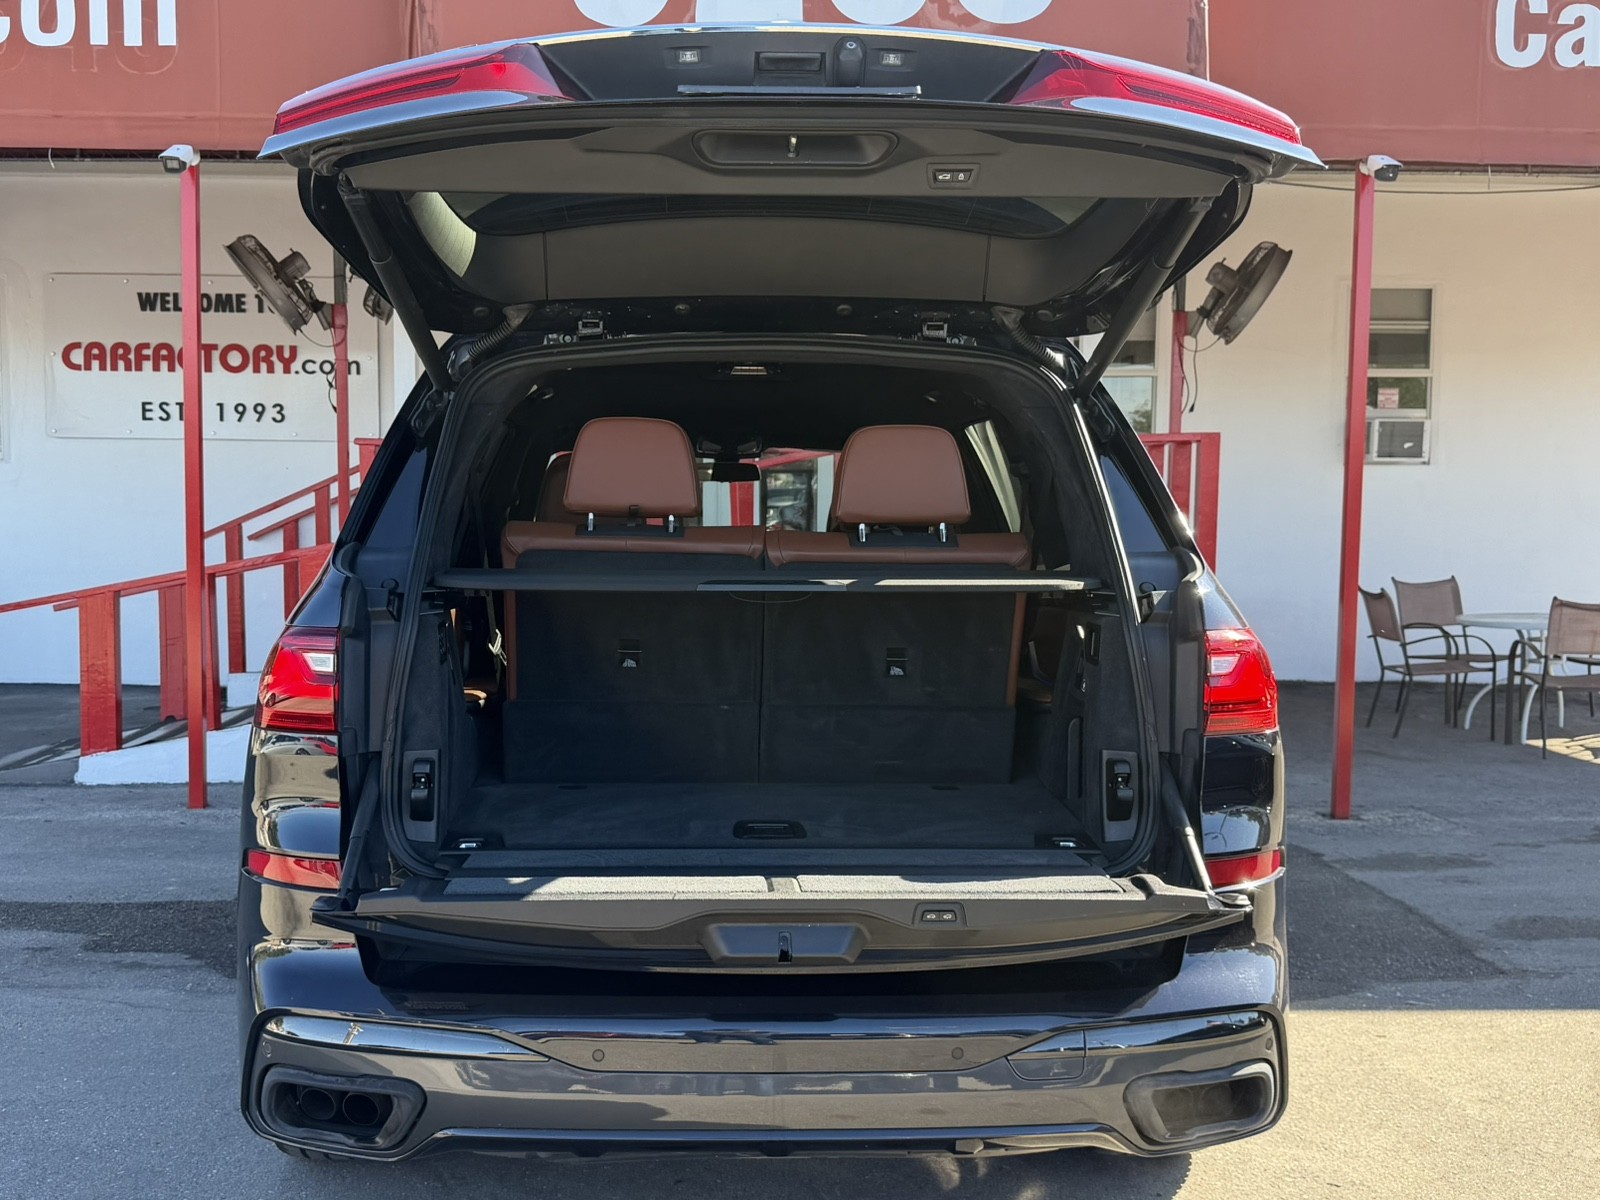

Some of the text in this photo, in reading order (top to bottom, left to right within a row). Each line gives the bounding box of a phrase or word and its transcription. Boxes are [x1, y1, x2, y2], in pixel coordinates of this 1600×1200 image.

[137, 292, 275, 314] WELOME T
[61, 341, 361, 375] CARFATORY.com
[216, 402, 286, 423] 1993
